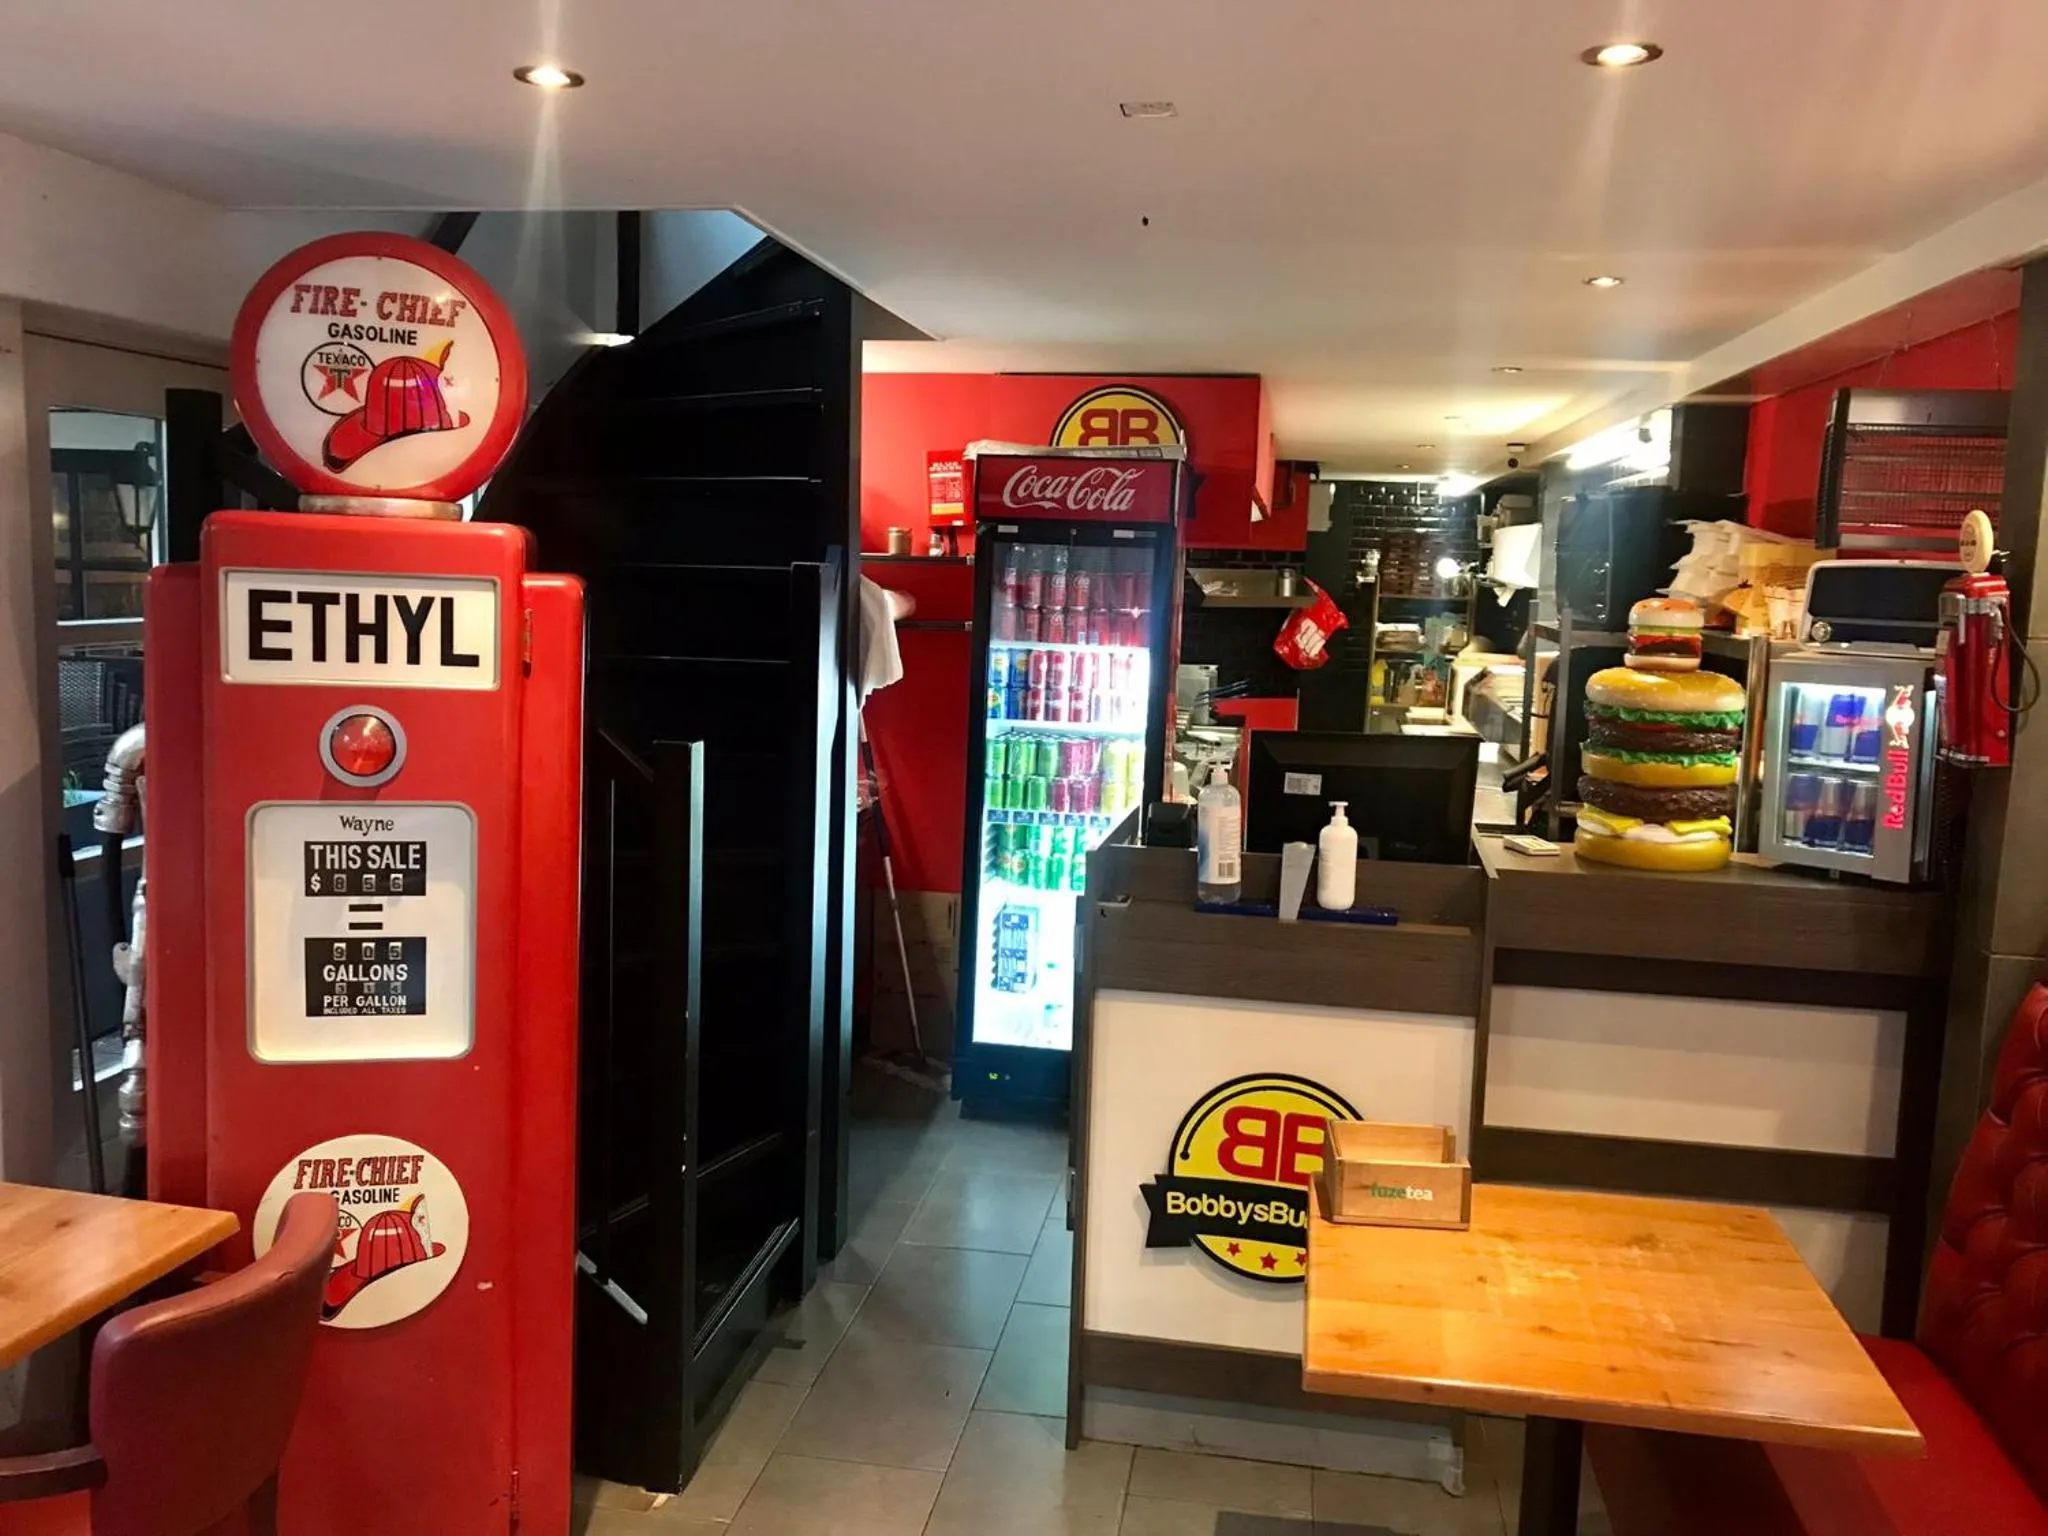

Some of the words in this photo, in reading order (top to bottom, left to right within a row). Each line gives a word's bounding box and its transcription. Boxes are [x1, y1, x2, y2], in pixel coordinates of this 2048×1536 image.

[376, 291, 467, 328] CHIEF
[328, 322, 418, 346] GASOLINE
[317, 351, 366, 367] TEXACO
[1003, 464, 1146, 511] Coca-Cola
[248, 589, 480, 668] ETHYL
[339, 815, 395, 837] Wayne
[310, 844, 362, 870] THIS
[366, 844, 420, 870] SALE
[310, 872, 321, 893] $
[323, 964, 409, 982] GALLONS
[323, 995, 349, 1007] PER
[356, 995, 407, 1007] GALLON
[1166, 1191, 1308, 1229] BobbysBu
